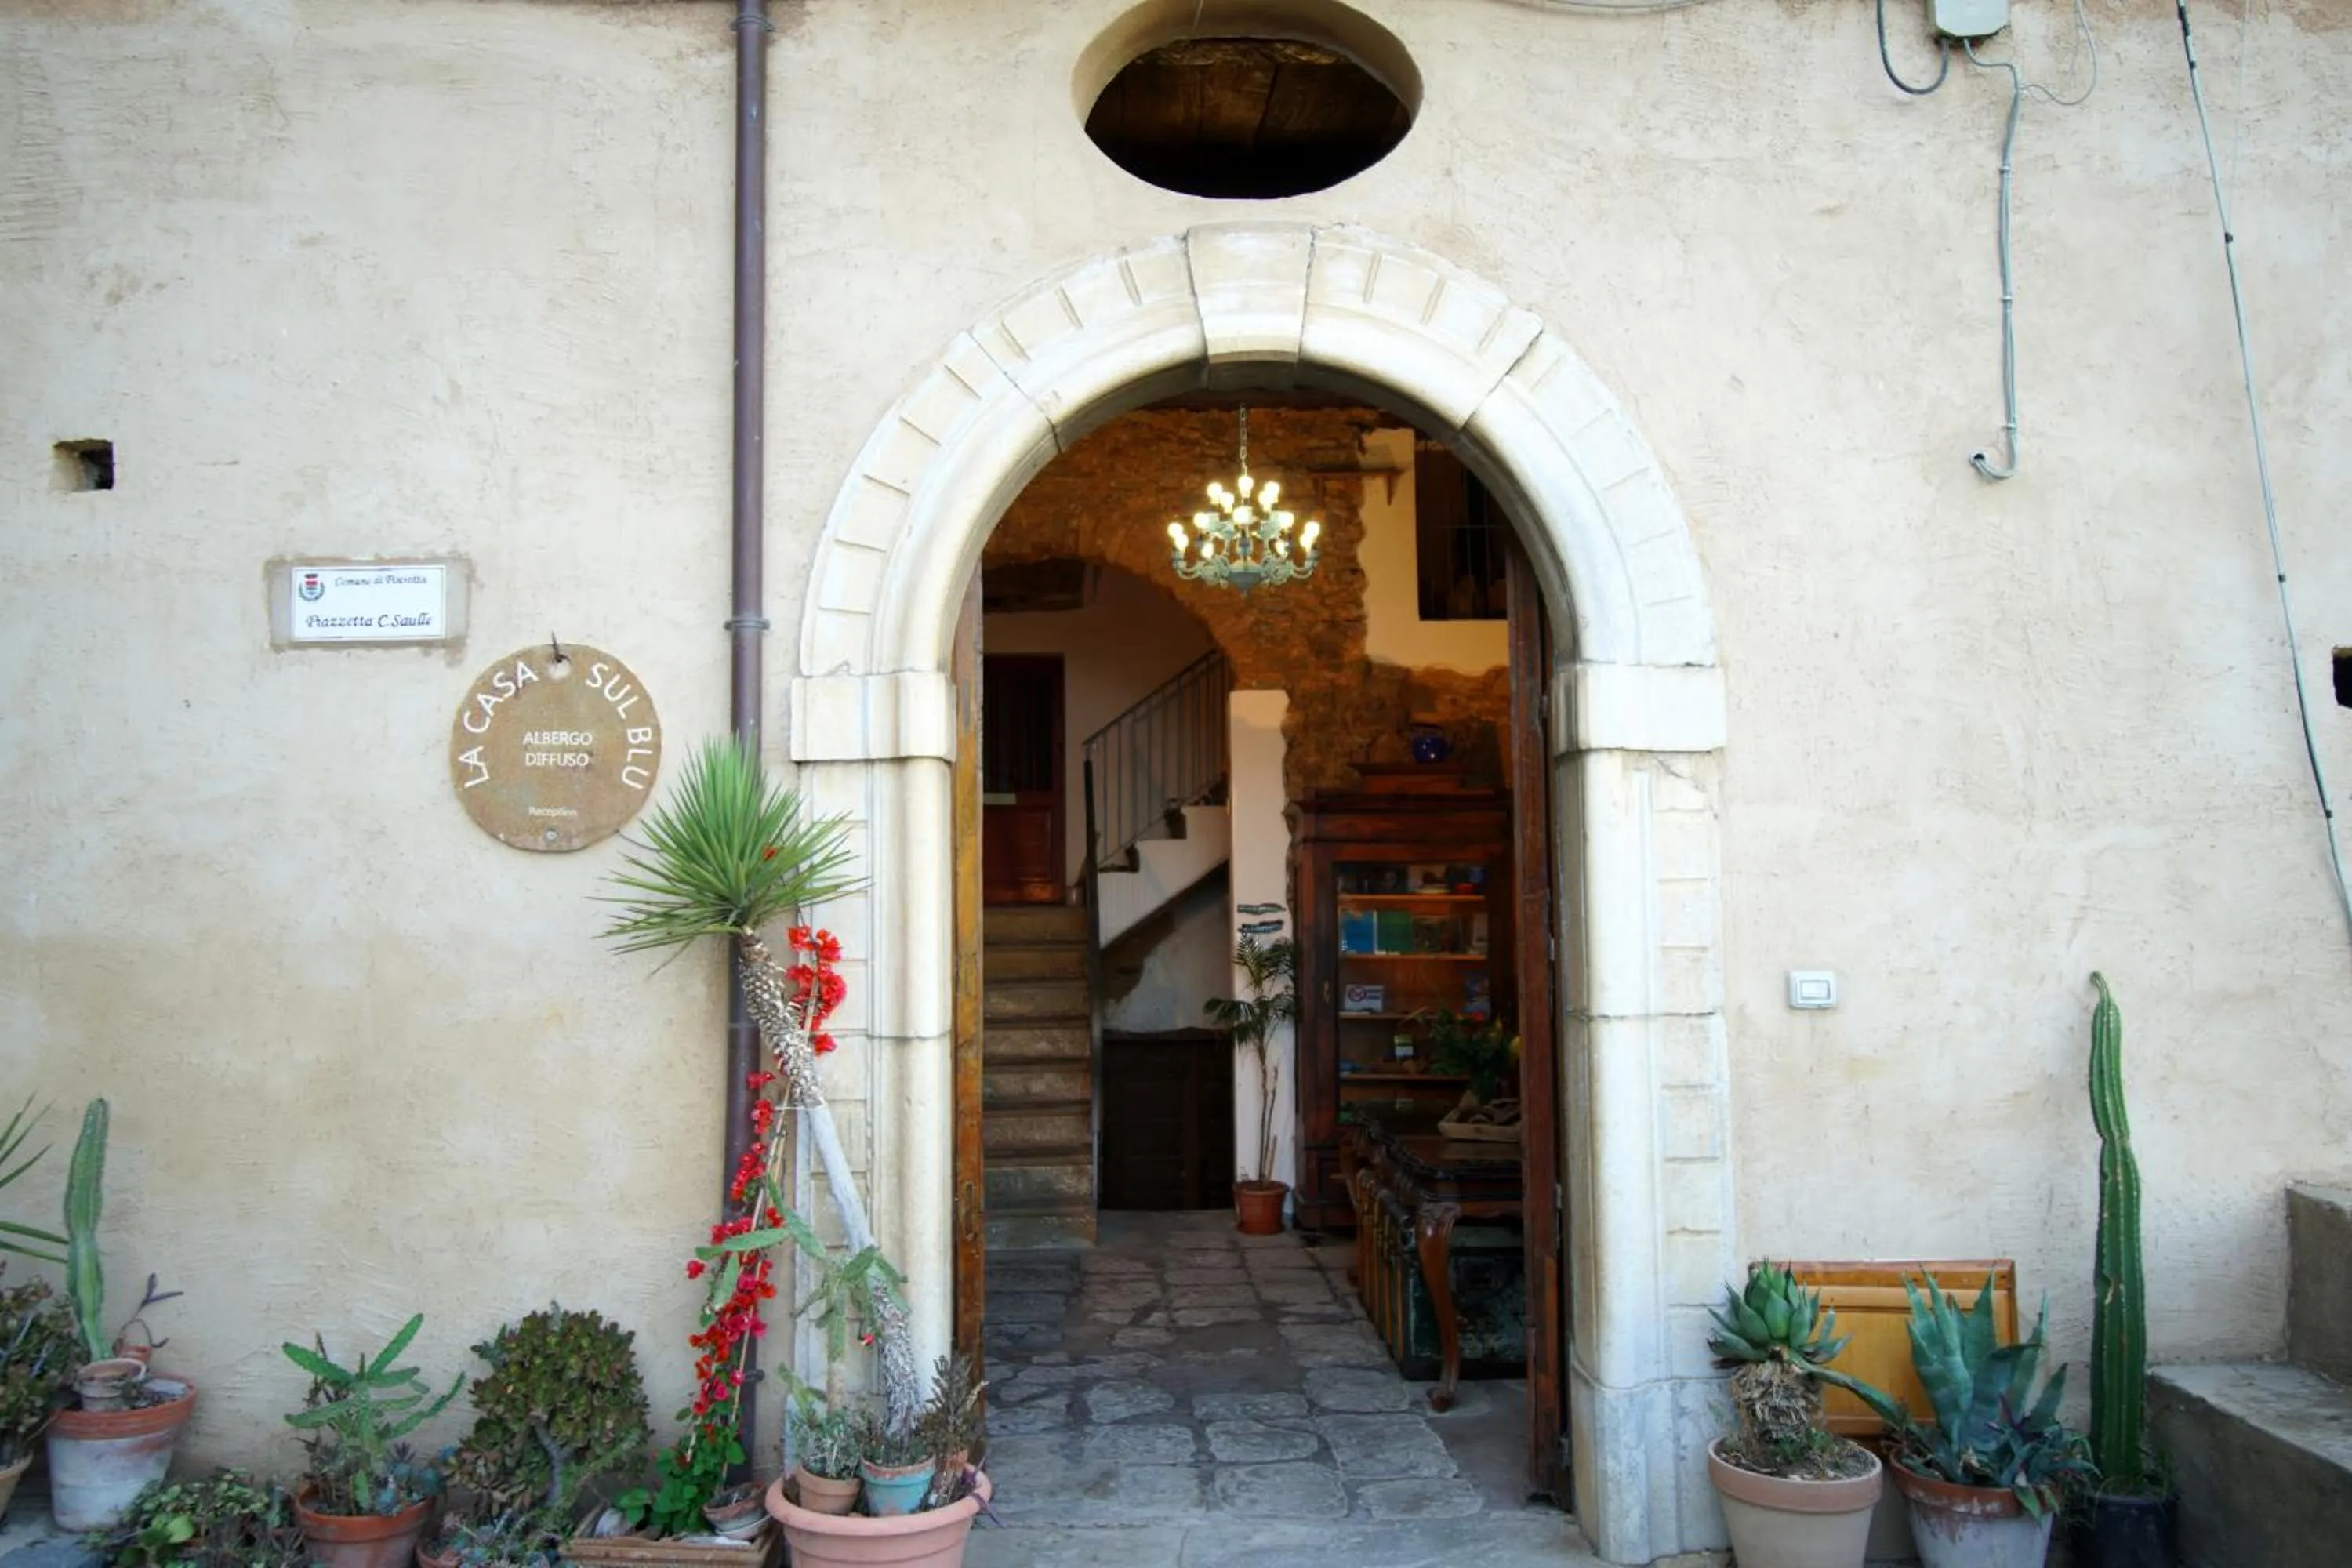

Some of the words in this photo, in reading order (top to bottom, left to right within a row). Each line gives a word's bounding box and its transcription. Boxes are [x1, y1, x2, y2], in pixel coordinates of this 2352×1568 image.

[374, 575, 383, 585] di
[305, 614, 373, 628] Piazzetta
[463, 660, 539, 734] CASA
[586, 662, 640, 720] SUL
[523, 731, 593, 746] ALBERGO
[458, 746, 490, 789] LA
[525, 752, 590, 767] DIFFUSO
[622, 727, 653, 789] BLU
